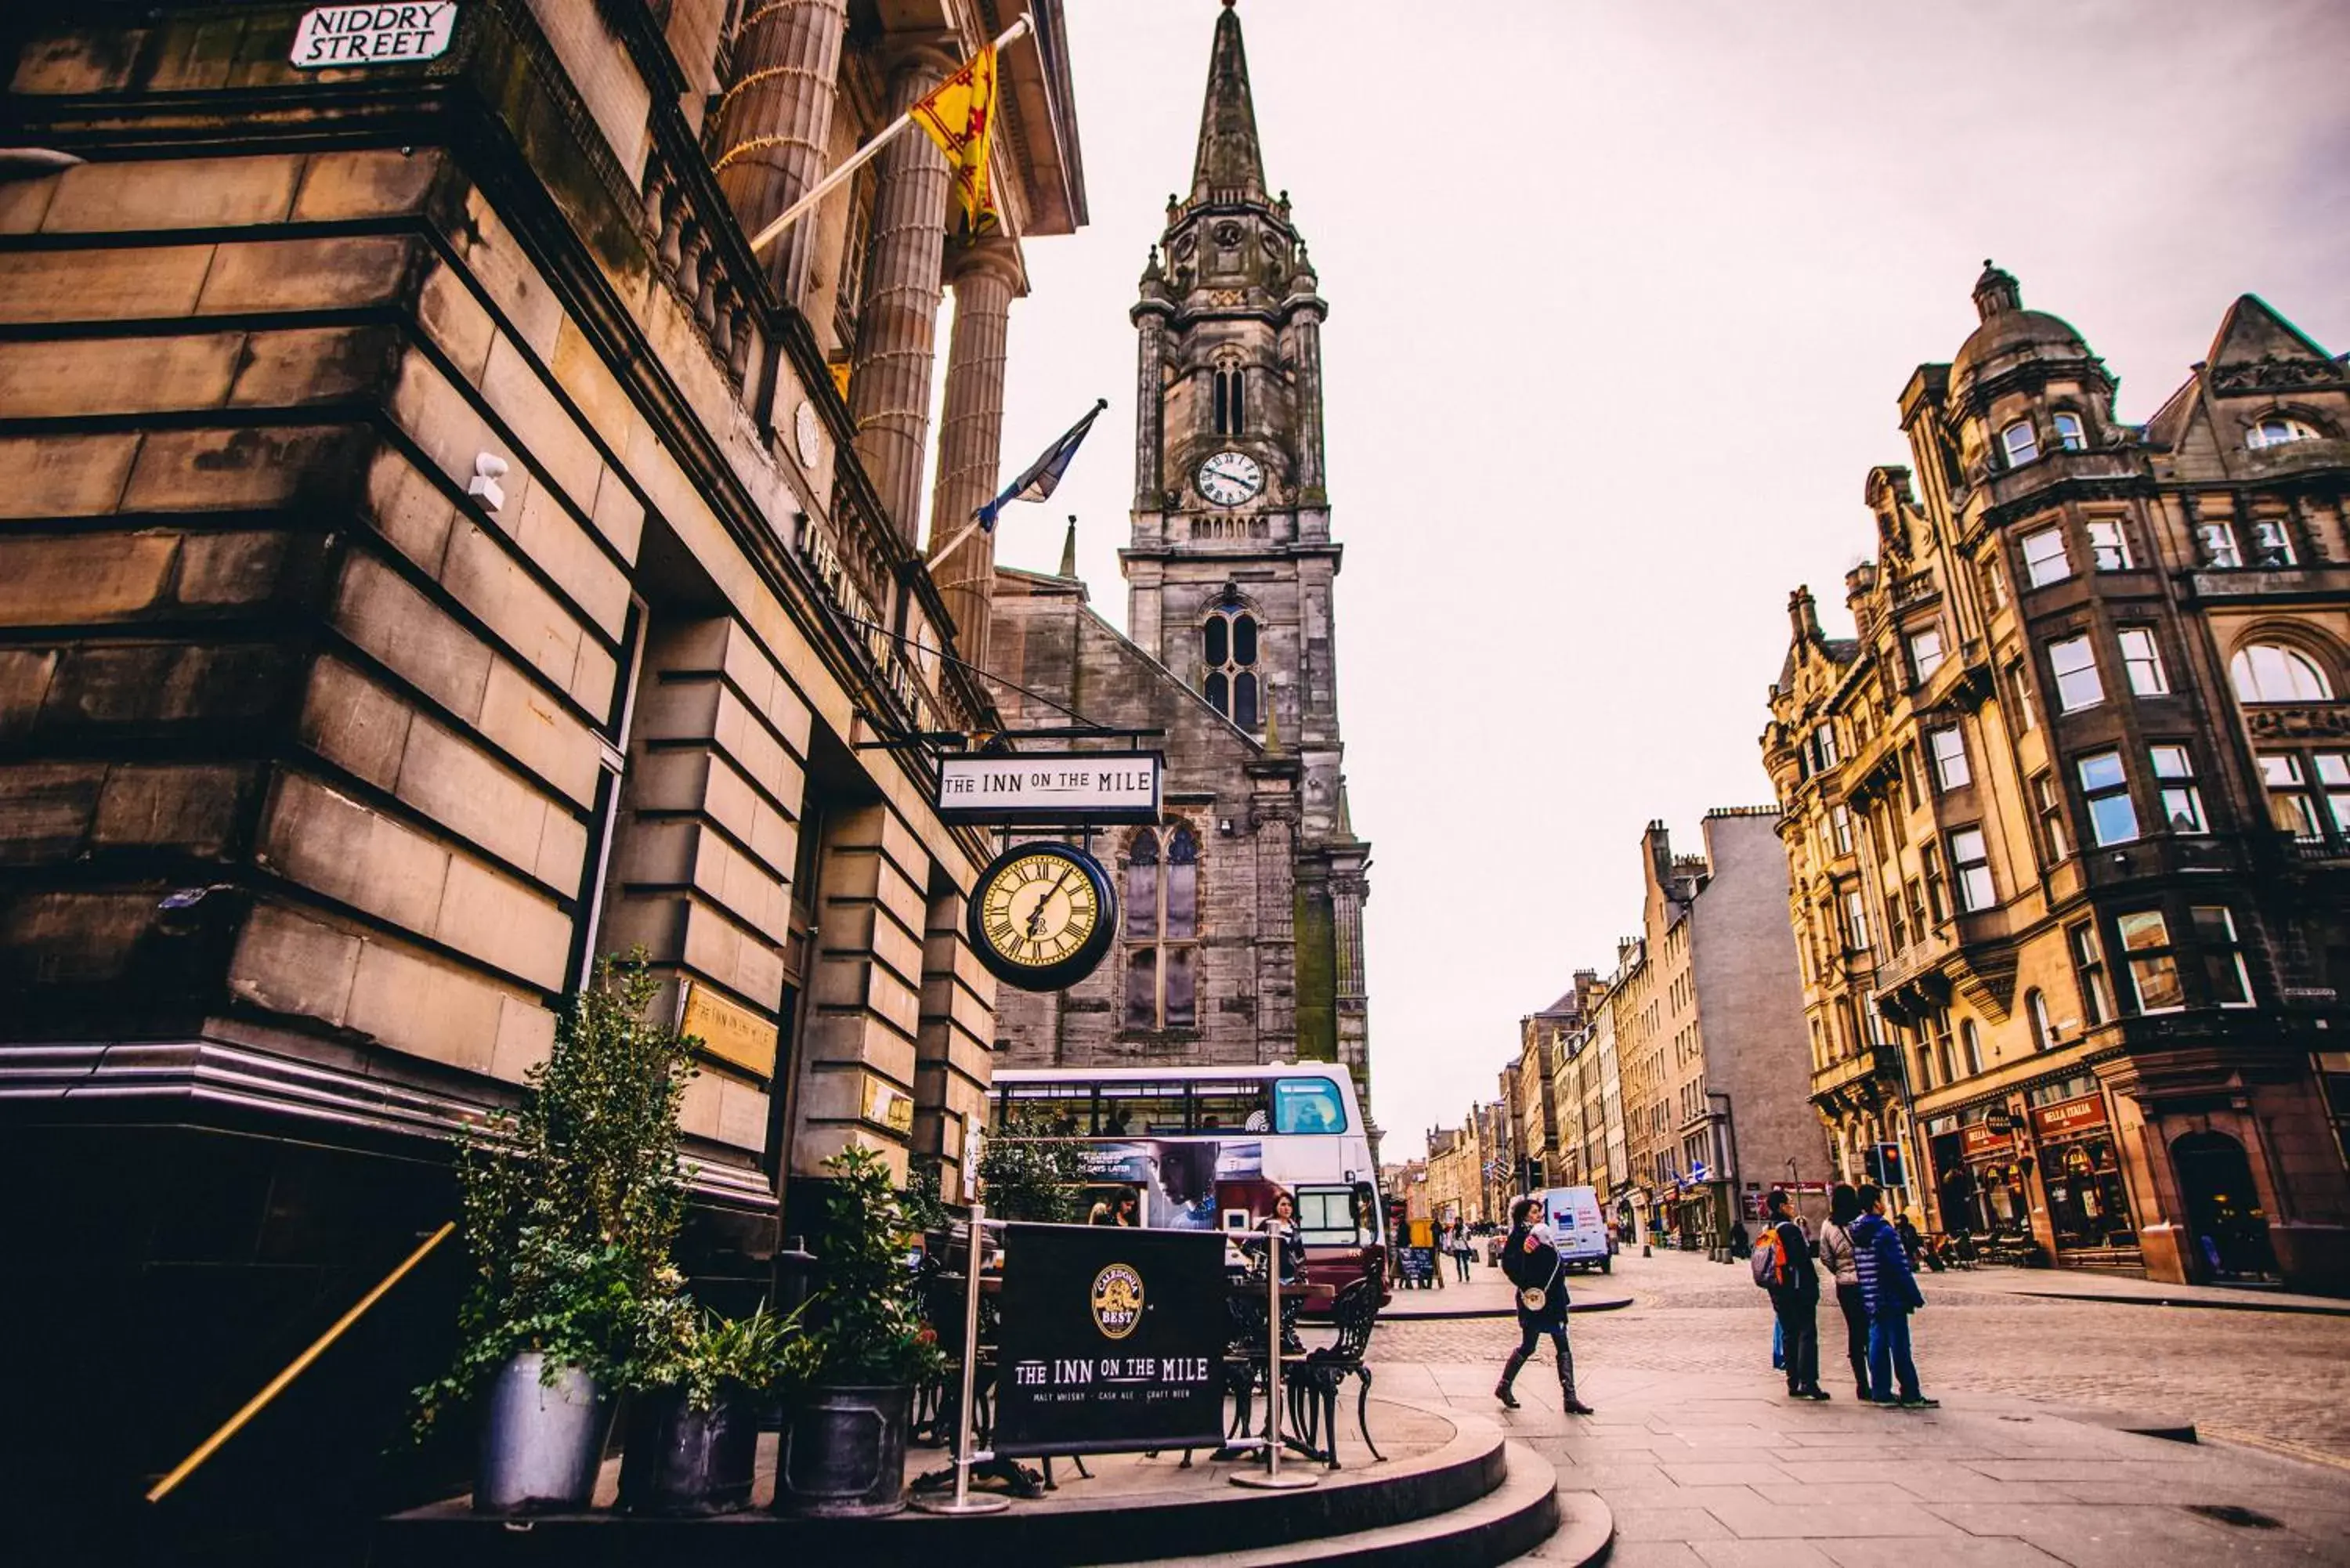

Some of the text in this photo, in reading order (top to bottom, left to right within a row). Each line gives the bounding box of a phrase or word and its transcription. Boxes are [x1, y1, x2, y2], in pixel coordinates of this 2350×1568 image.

[310, 5, 444, 34] NIDDRY
[306, 31, 435, 60] STREET
[944, 771, 1151, 793] THE INN ON THE MILE
[2044, 1108, 2066, 1124] BELLA
[1097, 1269, 1138, 1293] CALEDONIA
[1102, 1310, 1133, 1324] BEST
[1015, 1357, 1209, 1385] THE INN ON THE MILE
[1033, 1393, 1052, 1401] MALT
[1058, 1392, 1086, 1401] WHISKY
[1121, 1391, 1134, 1400] ALE
